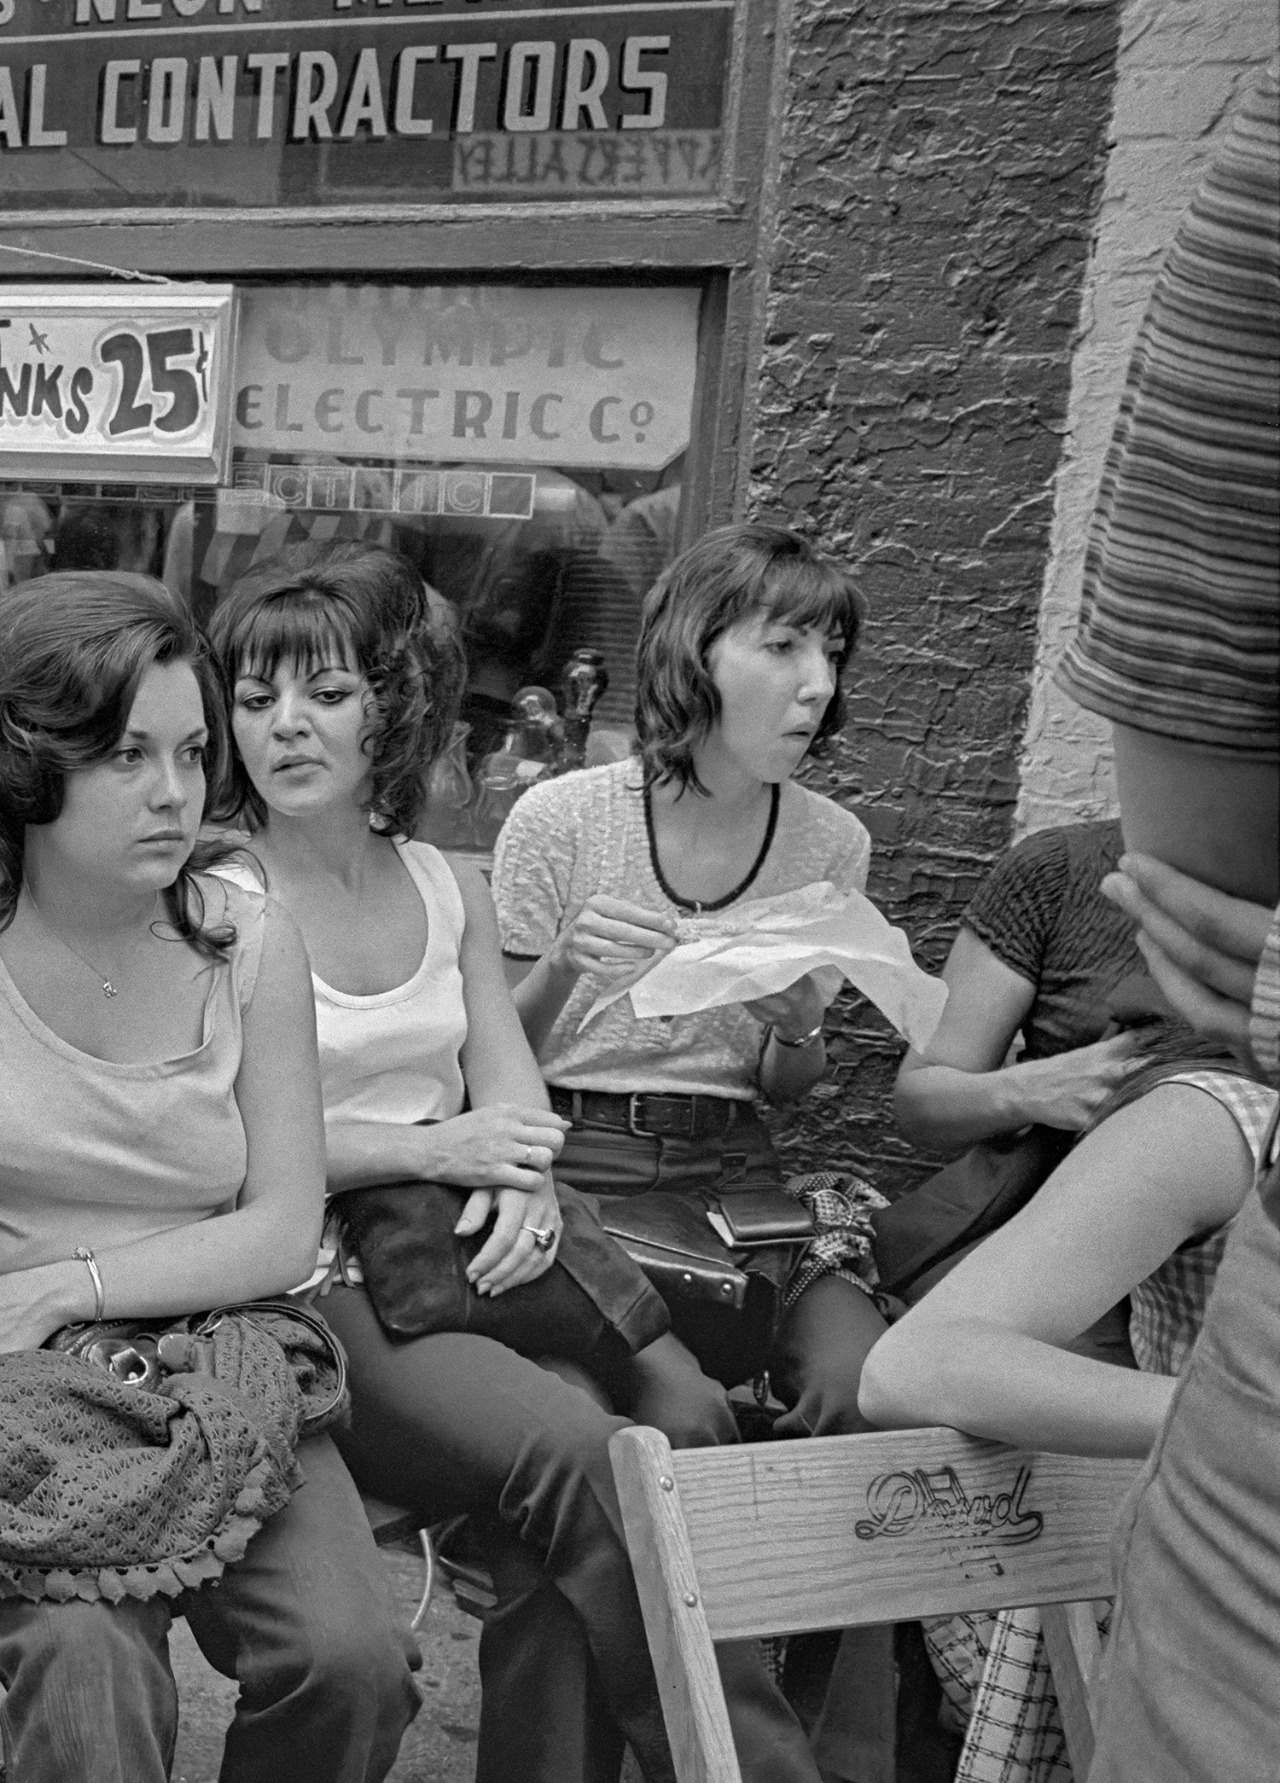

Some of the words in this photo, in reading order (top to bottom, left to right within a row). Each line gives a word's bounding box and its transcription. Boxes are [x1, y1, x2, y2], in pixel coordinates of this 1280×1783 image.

[99, 34, 672, 144] CONTRACTORS
[263, 312, 625, 370] OLYMPIC
[234, 383, 563, 441] ELECTRIC
